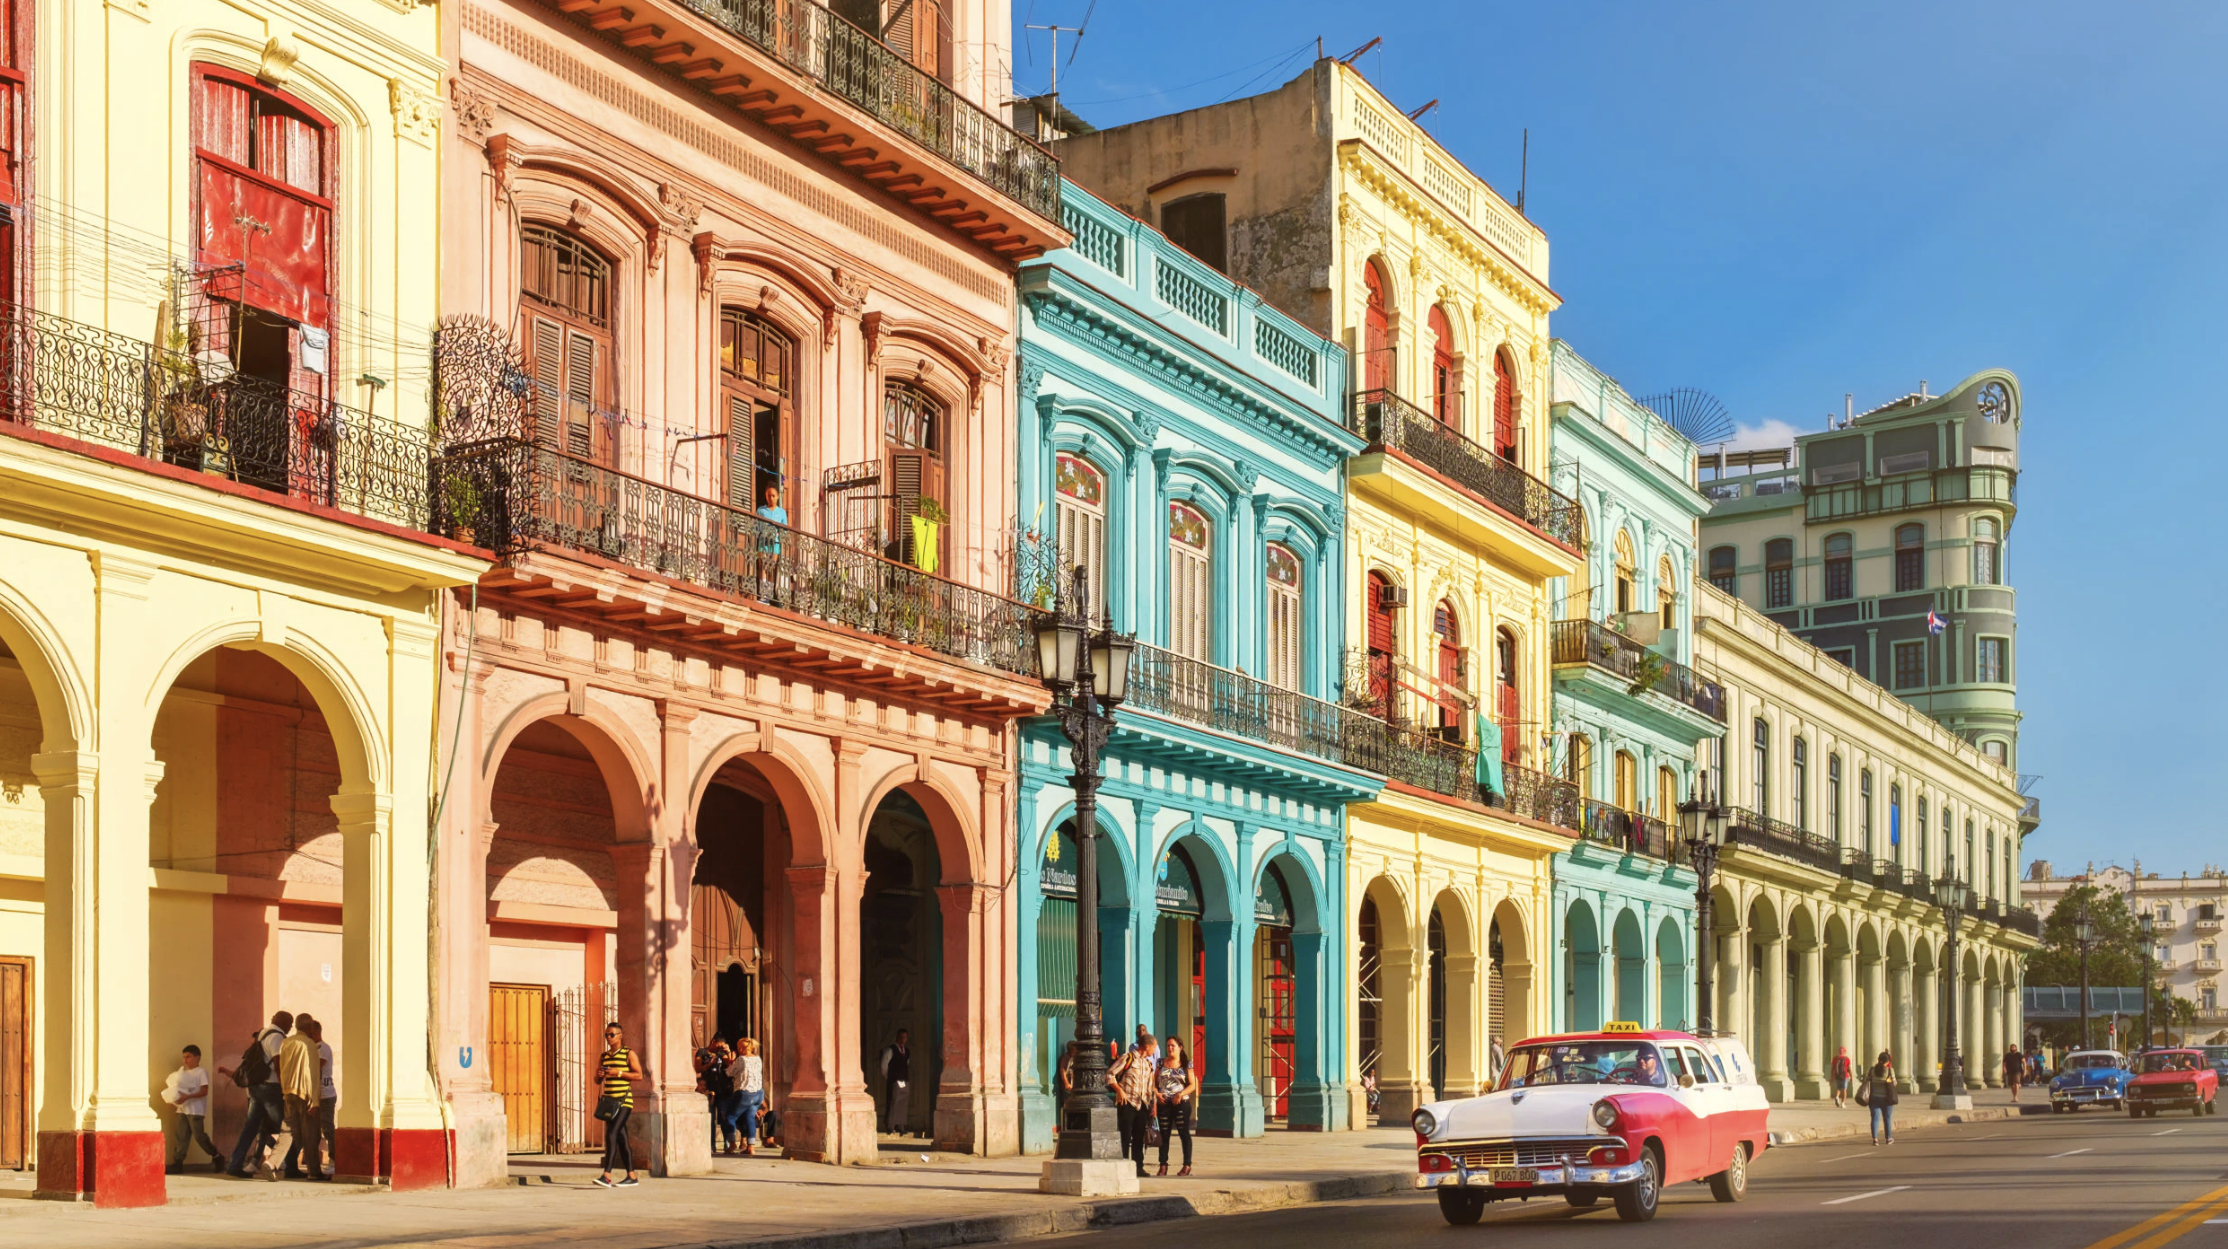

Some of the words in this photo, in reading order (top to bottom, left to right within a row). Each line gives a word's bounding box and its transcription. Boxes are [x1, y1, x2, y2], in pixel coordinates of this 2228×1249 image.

[1046, 867, 1077, 886] Nardos
[1494, 1170, 1500, 1181] P
[1501, 1170, 1517, 1181] 067
[1519, 1170, 1537, 1181] 800
